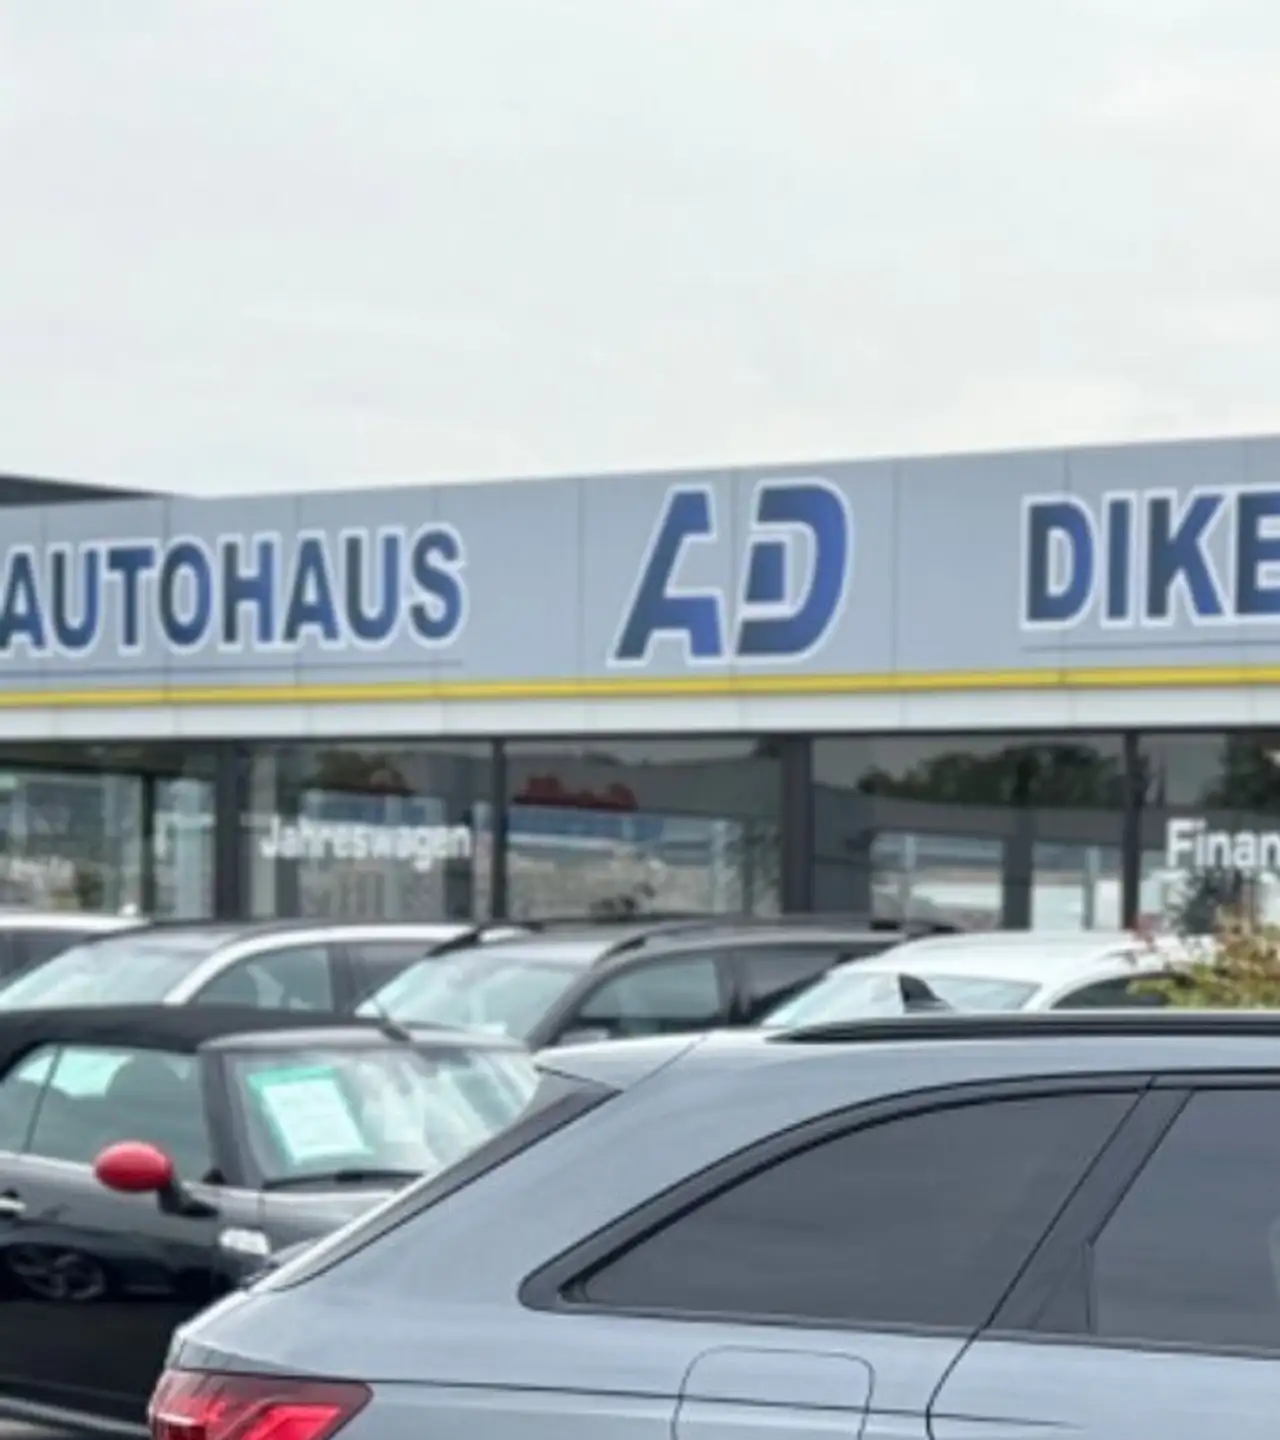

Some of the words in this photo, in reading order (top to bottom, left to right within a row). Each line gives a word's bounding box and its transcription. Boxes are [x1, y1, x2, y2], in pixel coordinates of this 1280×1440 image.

[0, 526, 465, 654] AUTOHAUS
[609, 478, 852, 666] AD
[260, 814, 472, 872] Jahreswagen
